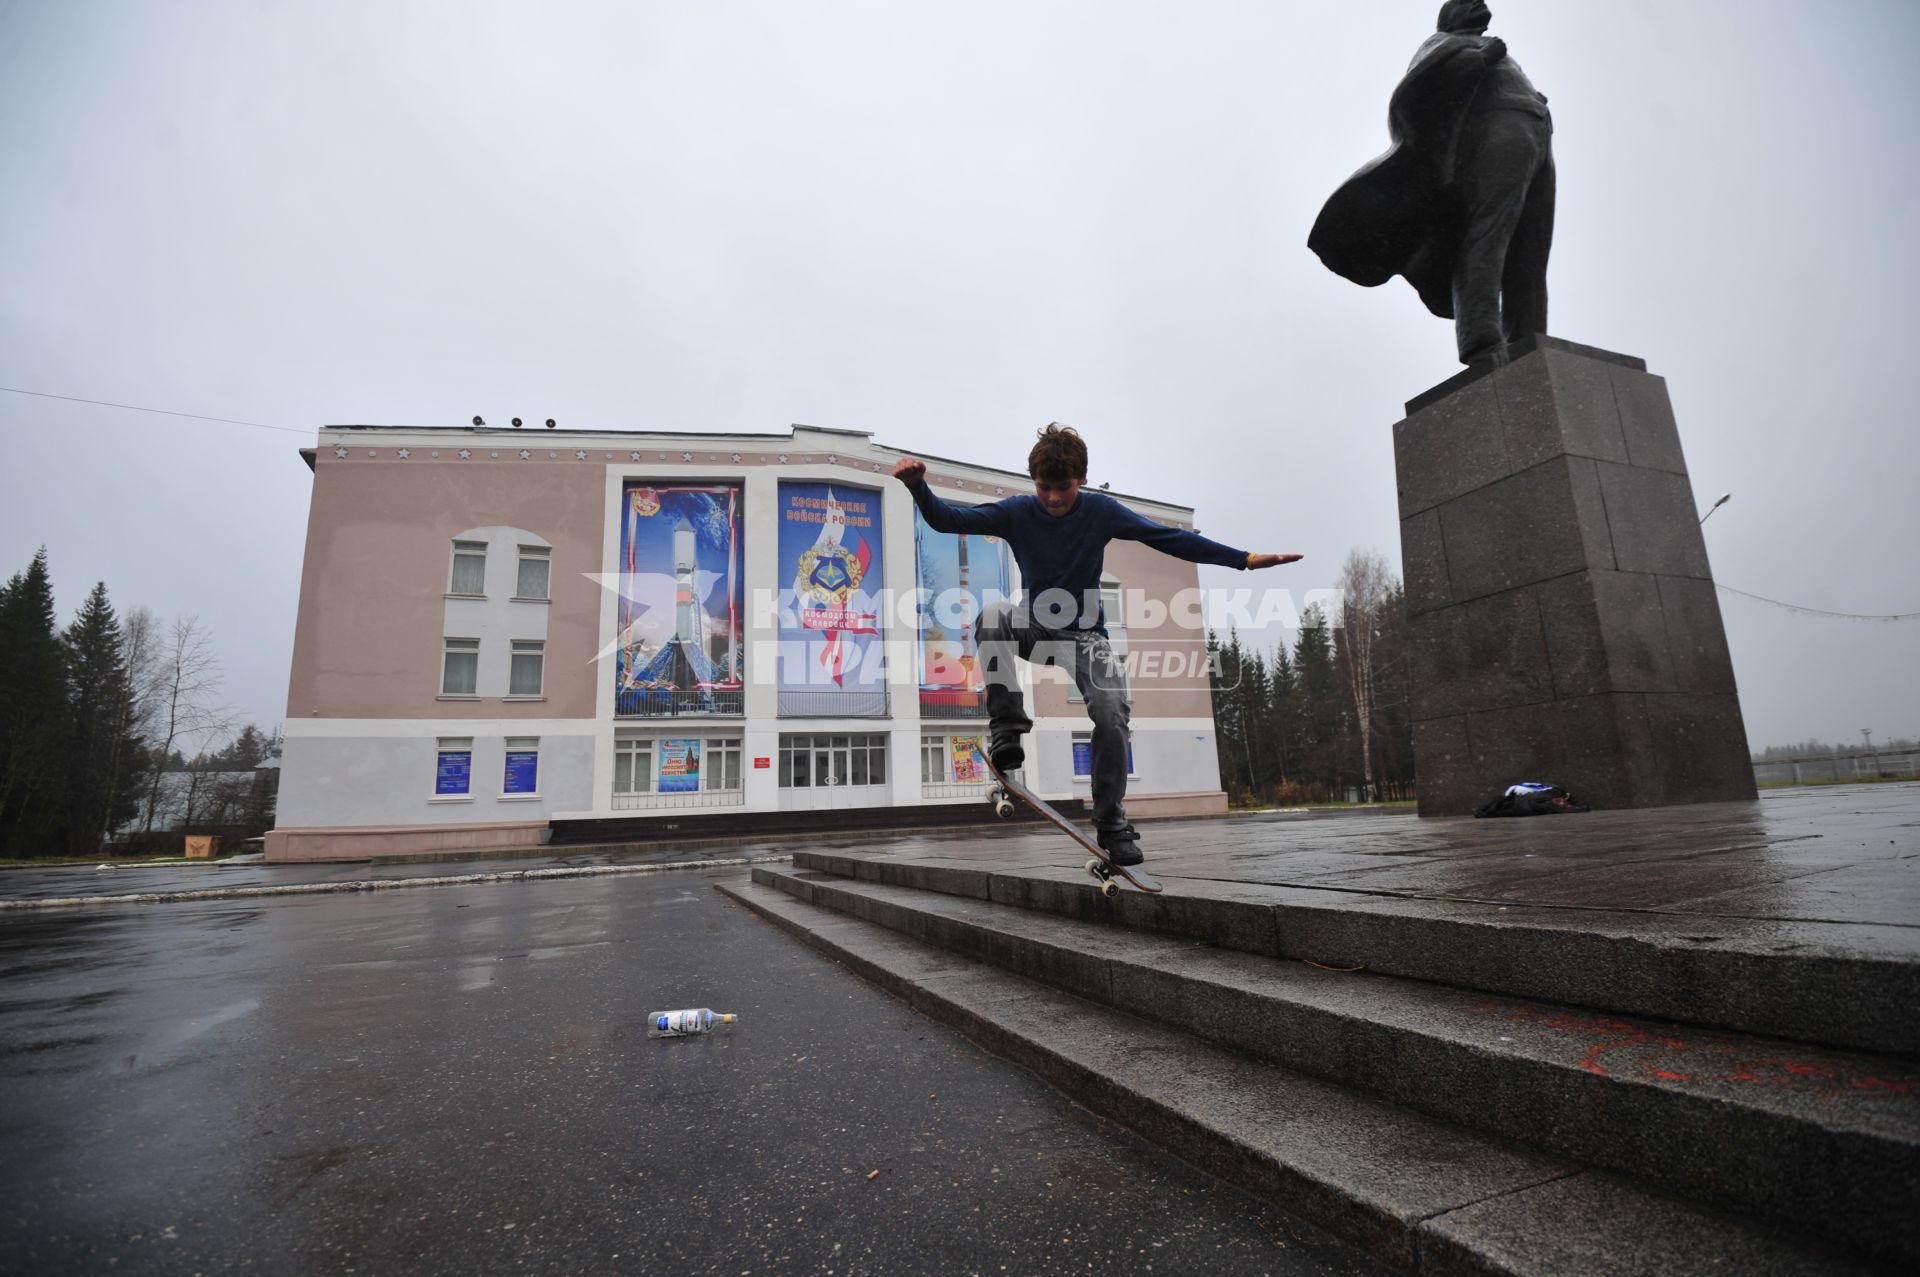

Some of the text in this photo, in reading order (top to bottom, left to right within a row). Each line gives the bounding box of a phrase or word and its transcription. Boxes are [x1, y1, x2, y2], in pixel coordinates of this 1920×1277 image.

[791, 496, 867, 512] КОСМИЧЕСКИЕ
[787, 509, 871, 527] ВОЙСКА РОССИИ
[804, 611, 857, 621] КОСМОДРОМ
